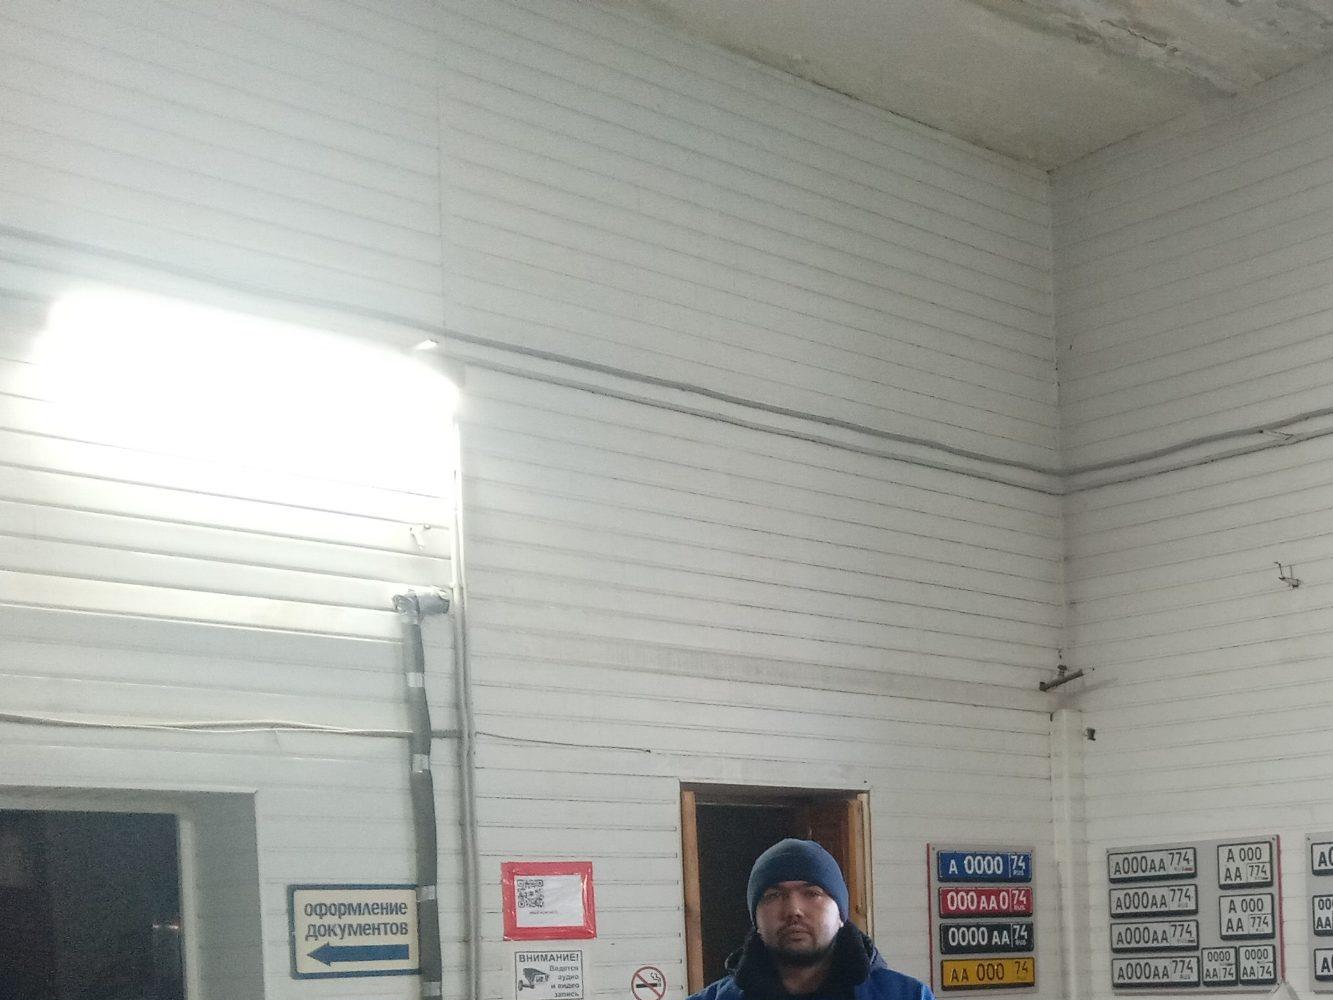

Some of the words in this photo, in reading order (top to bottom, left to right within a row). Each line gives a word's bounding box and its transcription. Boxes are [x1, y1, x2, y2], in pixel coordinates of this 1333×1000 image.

[1168, 851, 1190, 866] 774
[1239, 847, 1262, 862] 000
[964, 856, 1003, 874] 0000
[1011, 855, 1026, 870] 74
[1248, 864, 1267, 877] 774
[1012, 890, 1027, 905] 74
[1169, 888, 1191, 902] 774
[304, 902, 408, 919] оформление
[1241, 898, 1264, 913] 000
[1250, 916, 1269, 929] 774
[305, 922, 408, 941] документов
[1013, 925, 1027, 940] 74
[1171, 924, 1192, 938] 774
[519, 953, 579, 962] ВНИМАНИЕ!
[976, 963, 1005, 981] 000
[1014, 961, 1028, 974] 74
[1172, 959, 1193, 974] 774
[1222, 967, 1234, 978] 74
[1259, 965, 1272, 977] 74
